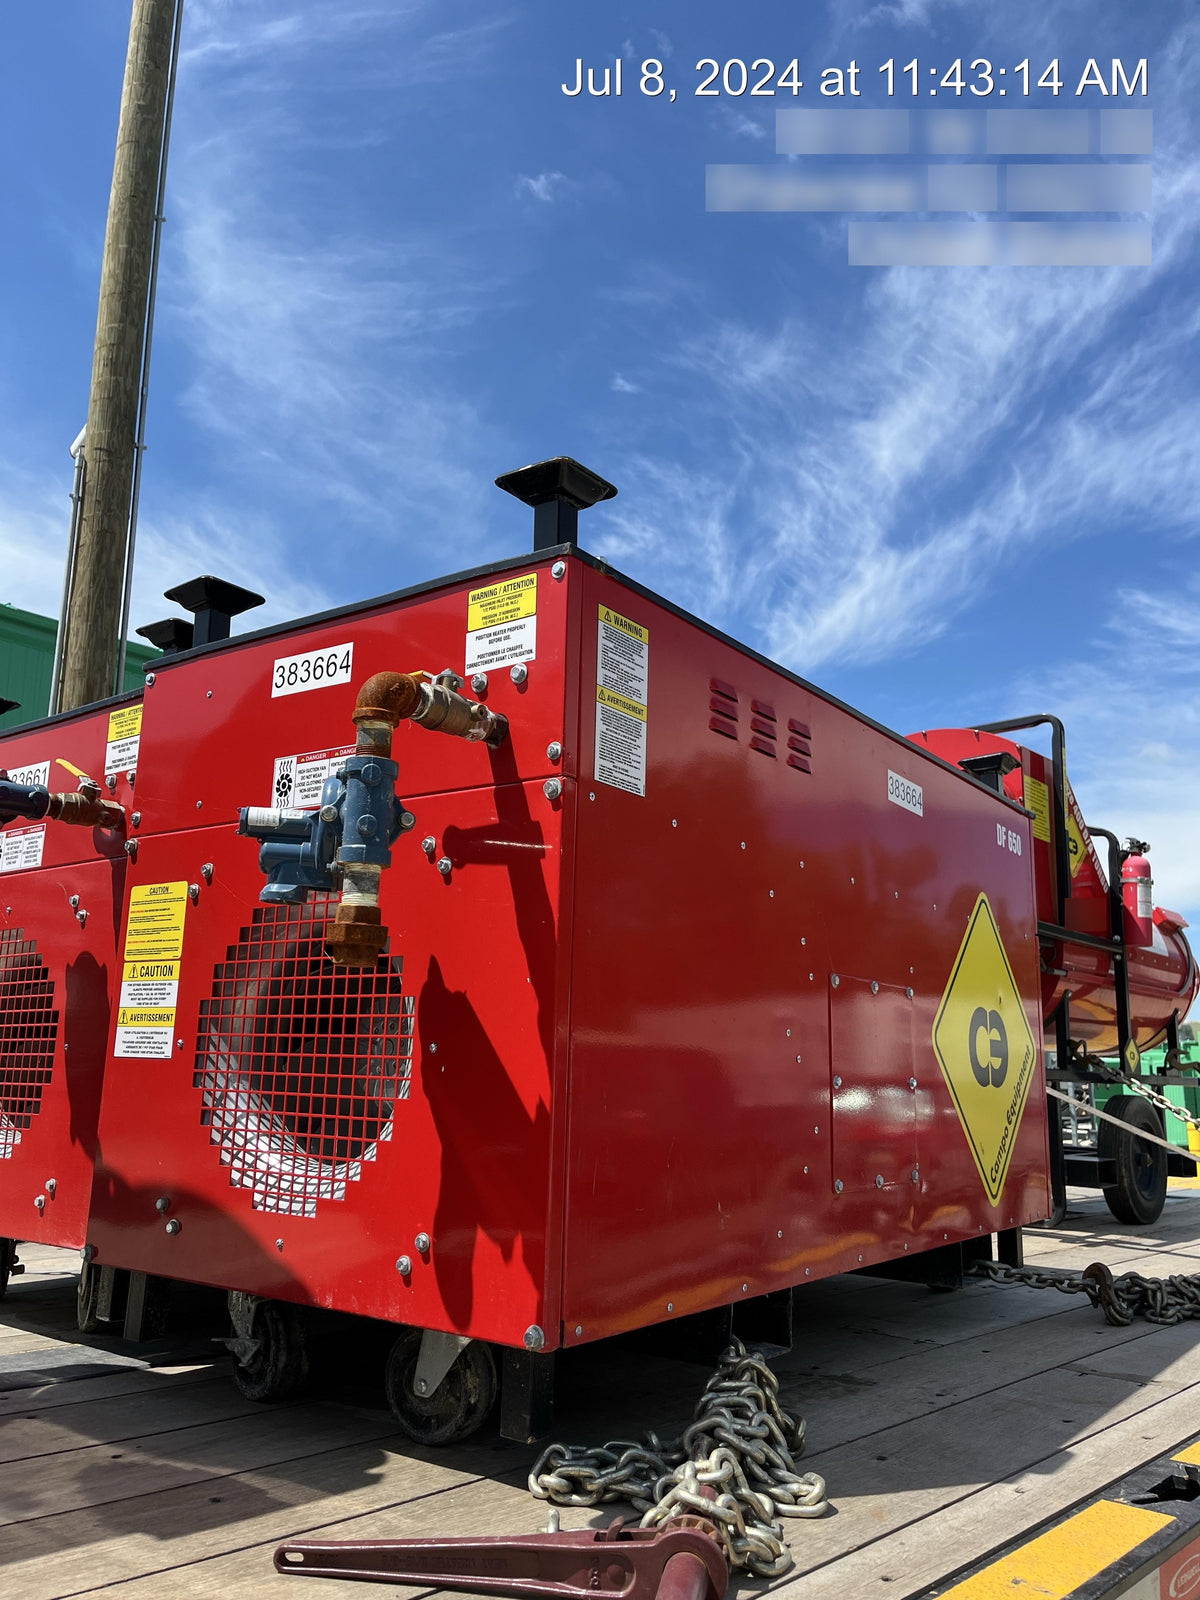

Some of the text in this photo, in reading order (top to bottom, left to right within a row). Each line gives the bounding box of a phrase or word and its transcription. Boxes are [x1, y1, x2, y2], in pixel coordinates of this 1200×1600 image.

[471, 588, 497, 602] WARNING
[503, 578, 534, 593] ATTENTION
[476, 633, 492, 641] POSITION
[507, 624, 526, 633] PROPERLY
[614, 614, 642, 638] WARNING
[488, 636, 502, 644] BEFORE
[274, 650, 351, 688] 383664
[607, 694, 644, 716] AVERTISSEMENT
[305, 747, 356, 761] DANGER DANGE
[888, 776, 922, 809] 383664
[997, 823, 1021, 856] DF 650
[149, 886, 169, 894] CAUTION
[140, 965, 173, 977] CAUTION
[130, 1014, 173, 1022] AVERTISSEMENT
[990, 1045, 1031, 1183] Campo Equipment
